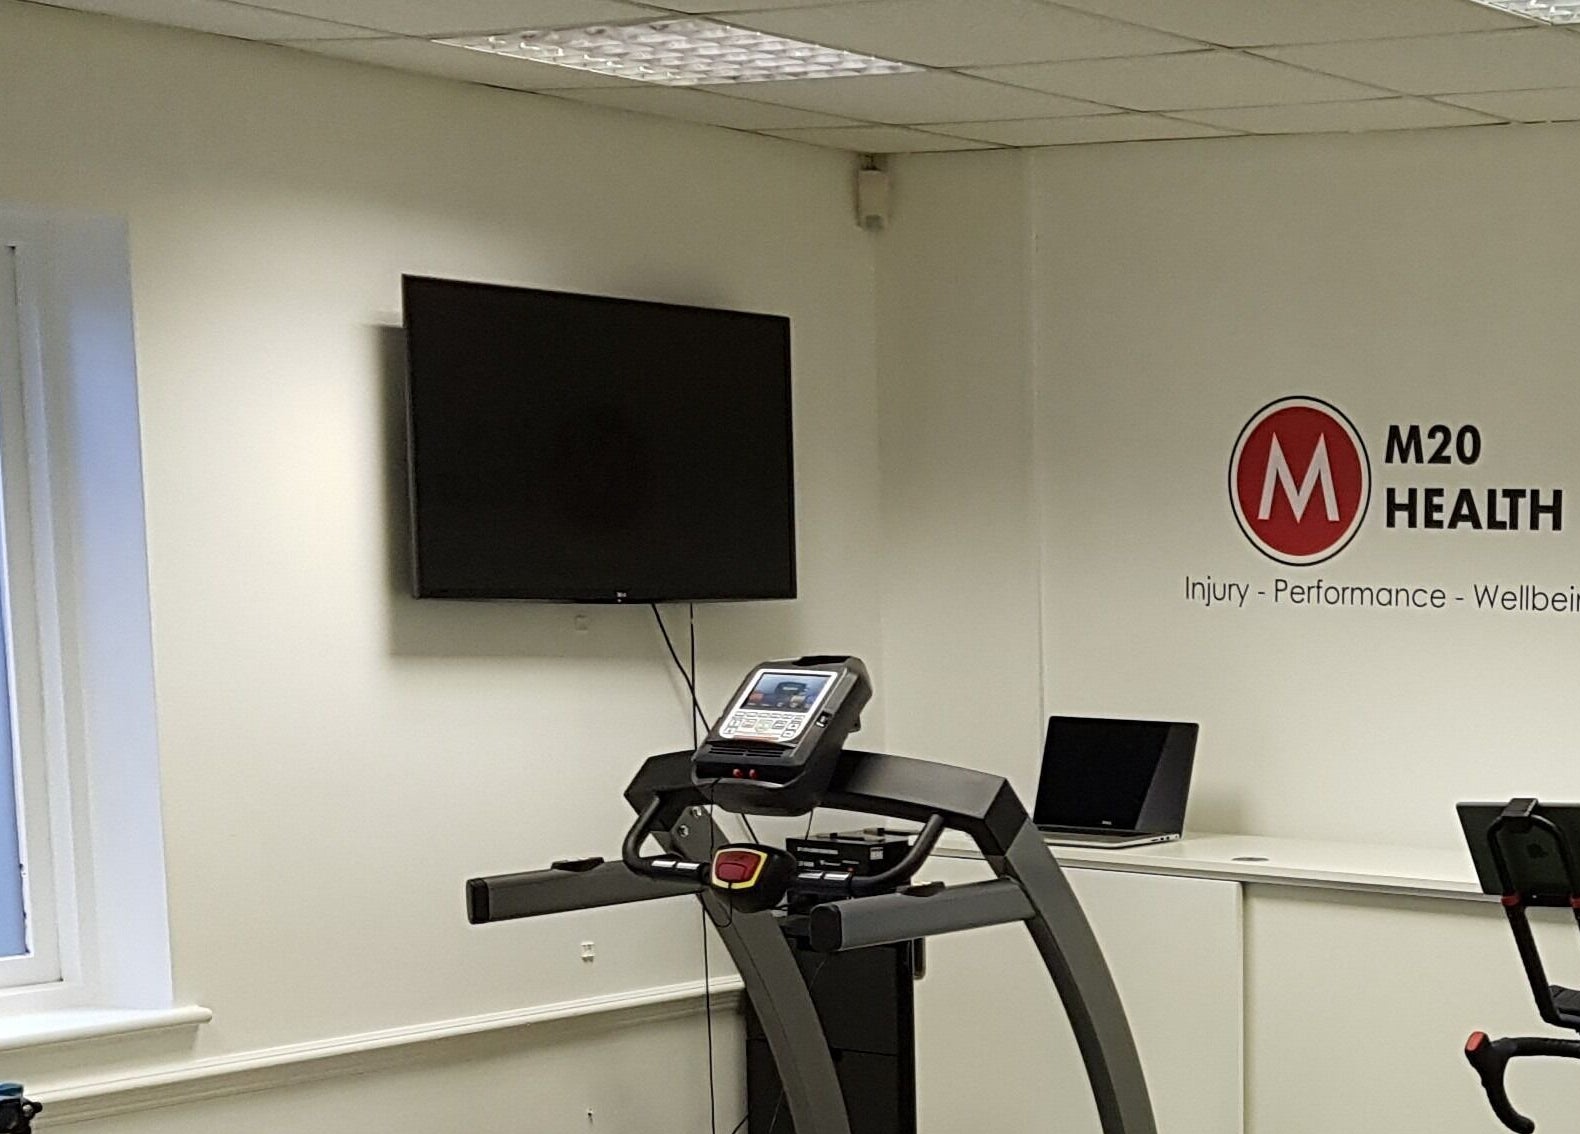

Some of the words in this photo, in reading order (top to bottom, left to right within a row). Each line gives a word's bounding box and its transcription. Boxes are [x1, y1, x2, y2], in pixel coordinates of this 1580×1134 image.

[1384, 424, 1482, 466] M20
[1257, 432, 1340, 524] M
[1385, 487, 1563, 531] HEALTH
[1185, 576, 1250, 608] Injury
[1274, 578, 1447, 608] Performance
